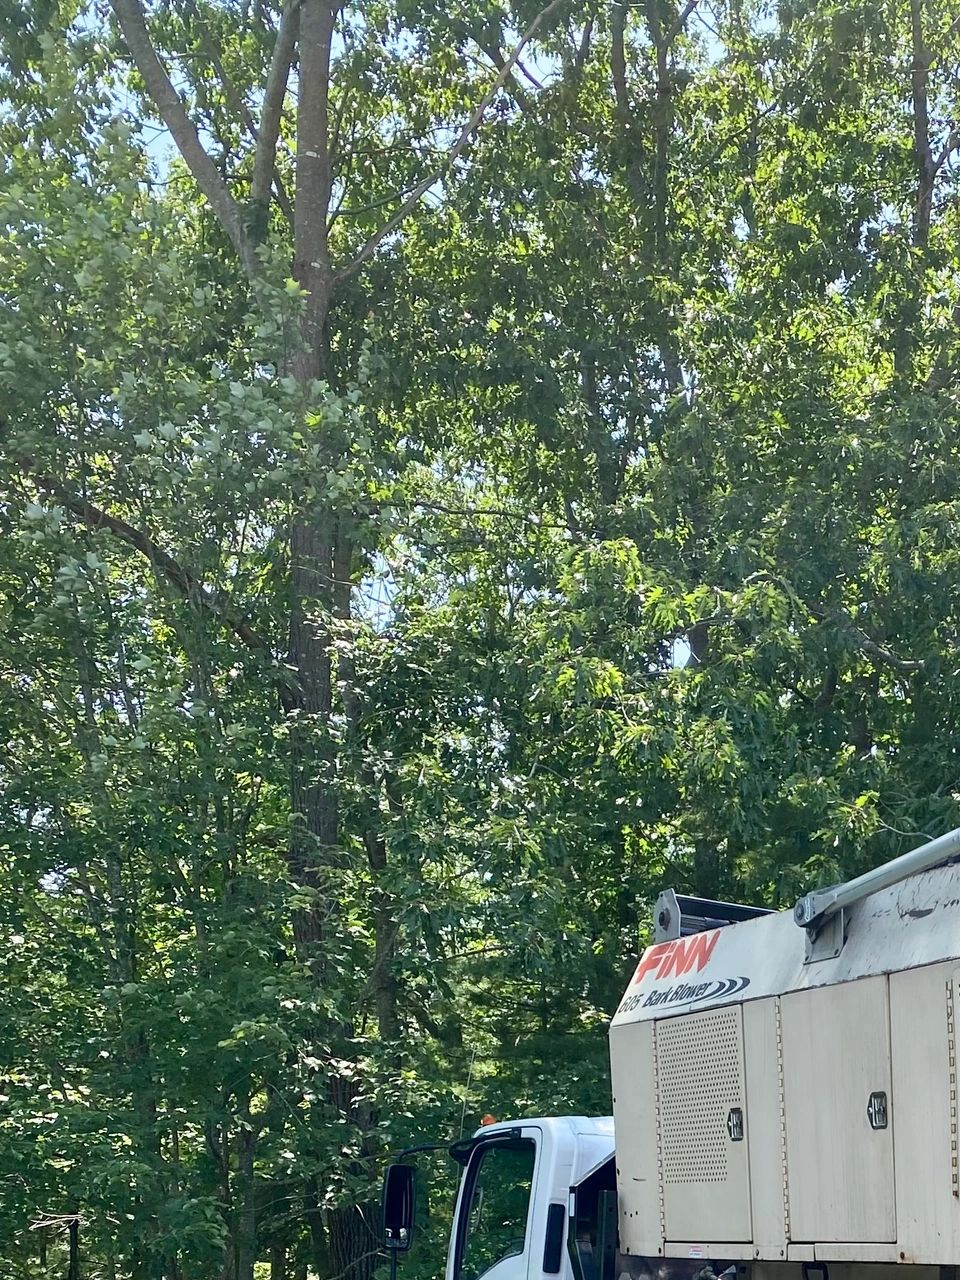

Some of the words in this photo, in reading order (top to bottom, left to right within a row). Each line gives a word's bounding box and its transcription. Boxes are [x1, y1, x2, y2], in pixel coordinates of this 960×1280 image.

[618, 993, 645, 1014] 605
[642, 986, 672, 1008] Bark
[668, 981, 713, 1003] Blower
